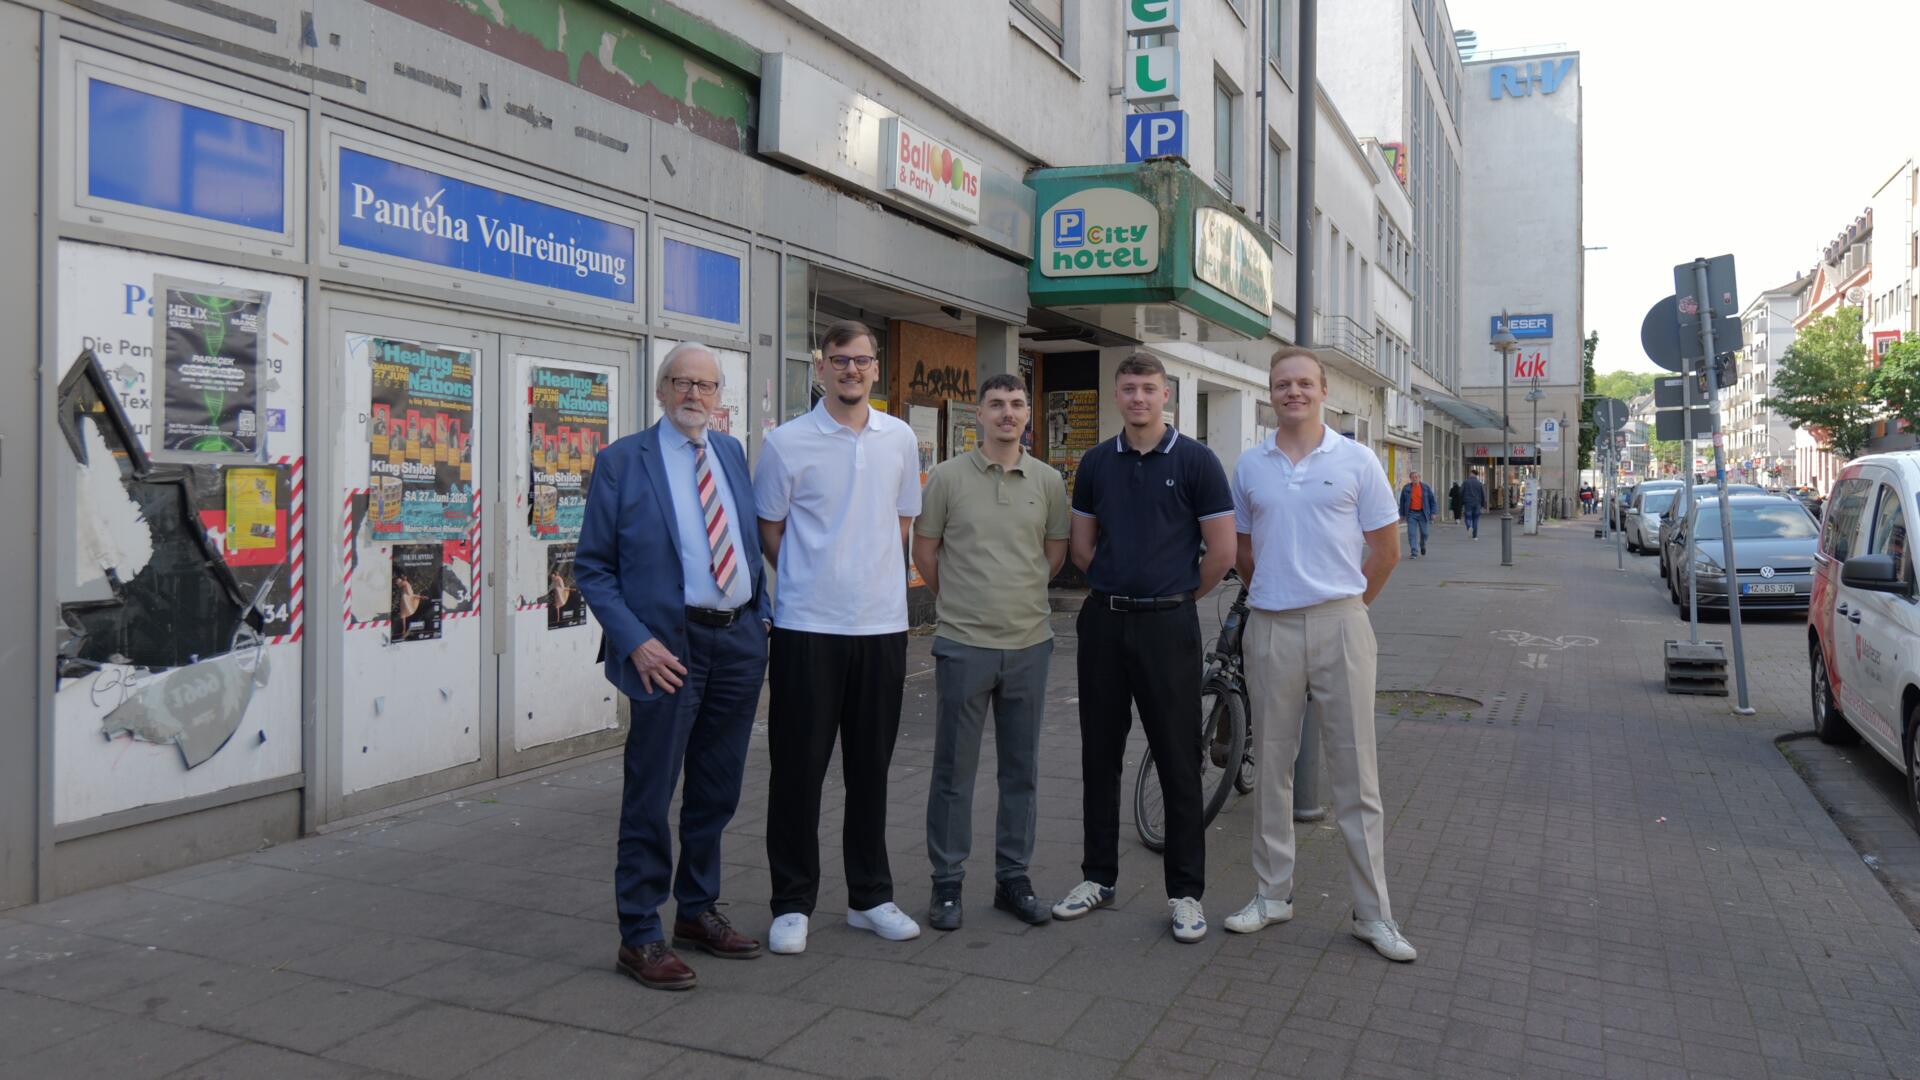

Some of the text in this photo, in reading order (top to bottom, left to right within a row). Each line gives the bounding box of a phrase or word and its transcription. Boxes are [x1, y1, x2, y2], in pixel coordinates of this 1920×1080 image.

[1489, 57, 1575, 100] R+V
[1150, 118, 1176, 155] P
[900, 165, 934, 200] & Party
[1059, 213, 1080, 236] P
[1087, 225, 1148, 245] City
[475, 215, 627, 285] Vollreinigung
[169, 304, 208, 320] HELIX
[82, 336, 112, 354] Die
[384, 344, 453, 376] Healing
[1514, 352, 1547, 378] kik
[408, 372, 472, 397] Nations
[539, 370, 593, 392] Healing
[559, 394, 608, 412] Nations
[371, 460, 436, 475] King Shiloh
[533, 471, 582, 484] King Shiloh
[405, 490, 416, 501] SA
[432, 492, 449, 502] Juni
[559, 497, 569, 506] SA
[263, 603, 289, 623] 34
